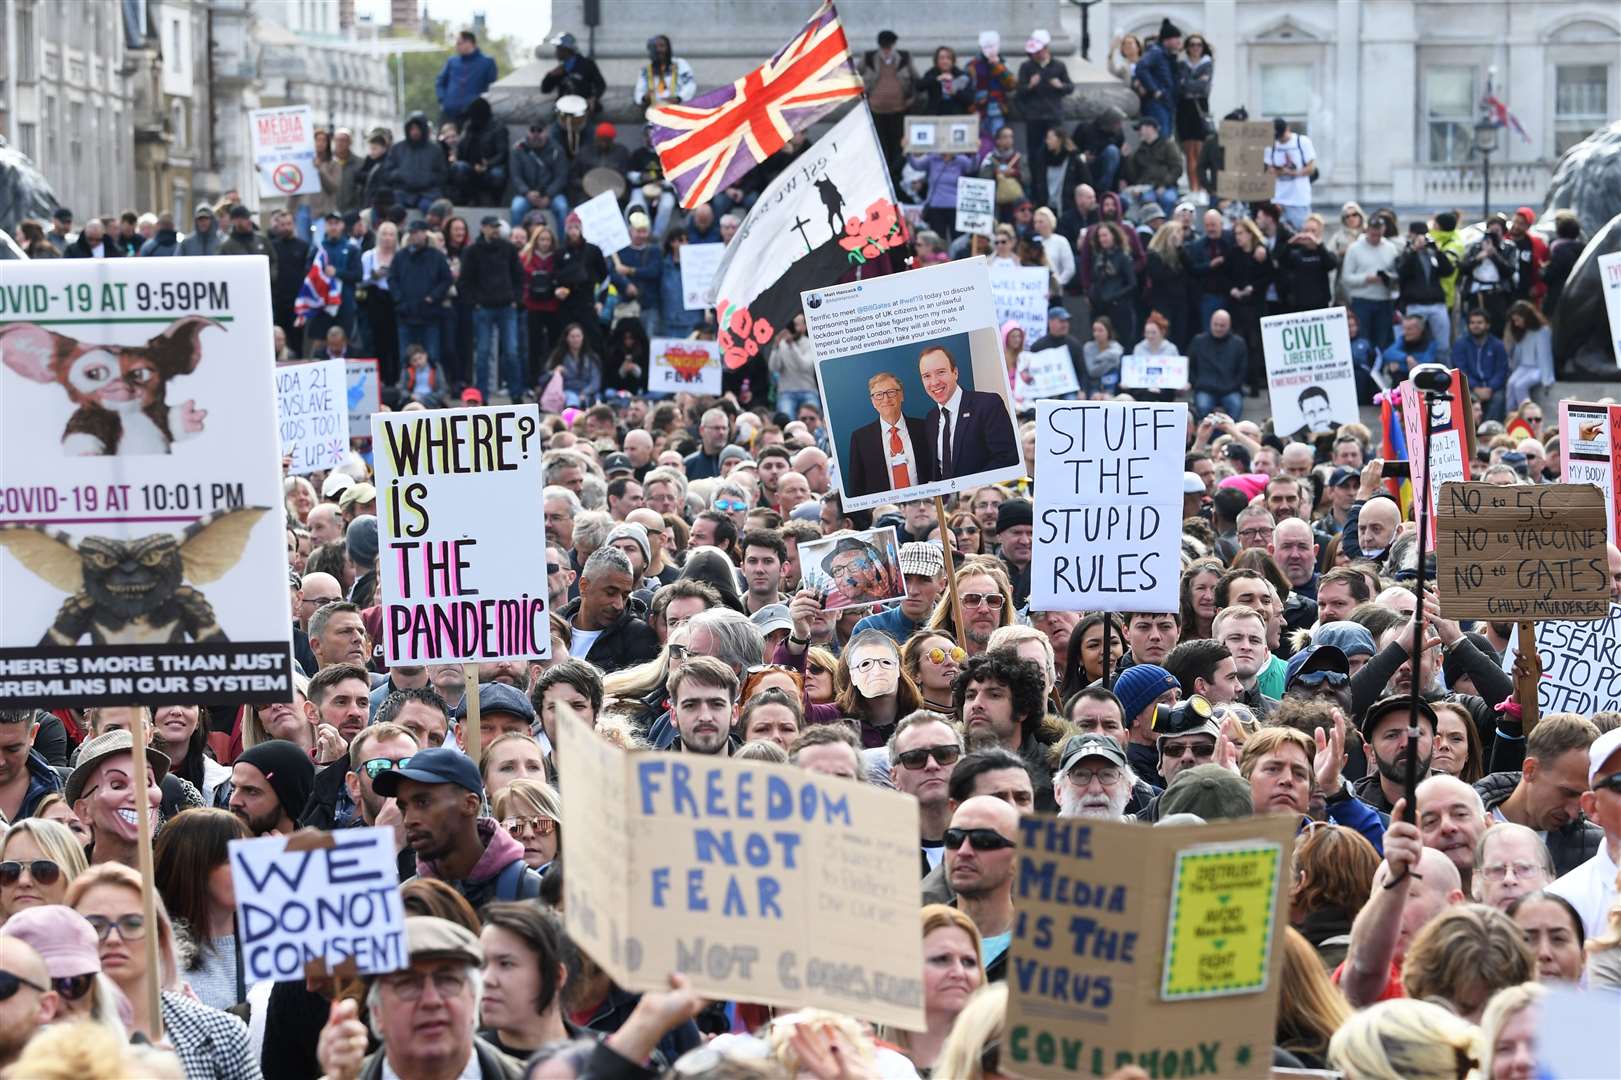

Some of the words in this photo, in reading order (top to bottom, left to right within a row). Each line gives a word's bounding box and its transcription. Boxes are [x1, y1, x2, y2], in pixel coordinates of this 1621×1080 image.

[257, 117, 303, 136] MEDIA
[0, 283, 92, 313] OVID-19
[101, 283, 128, 311] AT
[136, 282, 229, 311] 9:59PM
[811, 313, 830, 321] Terrific
[924, 292, 941, 300] today
[950, 285, 974, 294] discuss
[812, 319, 848, 332] imprisoning
[849, 314, 873, 324] millions
[893, 306, 917, 315] citizens
[935, 296, 961, 306] unlawful
[813, 329, 843, 339] lockdown
[845, 325, 864, 333] based
[875, 319, 890, 327] false
[892, 315, 913, 325] figures
[815, 338, 840, 348] Imperial
[894, 325, 908, 334] They
[863, 337, 894, 348] eventually
[1281, 323, 1331, 350] CIVIL
[1284, 348, 1332, 364] LIBERTIES
[384, 412, 535, 477] WHERE?
[1048, 406, 1175, 456] STUFF
[1064, 457, 1150, 495] THE
[1569, 465, 1583, 478] MY
[1585, 466, 1606, 482] BODY
[106, 485, 131, 511] AT
[142, 483, 202, 511] 10:01
[212, 483, 245, 509] PM
[1450, 486, 1482, 518] NO
[1491, 497, 1505, 508] to
[1517, 490, 1557, 522] 5G
[1039, 505, 1160, 543] STUPID
[1454, 526, 1488, 556] NO
[1514, 527, 1608, 552] VACCINES
[389, 539, 479, 598] THE
[1053, 553, 1160, 594] RULES
[1454, 563, 1483, 595] NO
[1491, 566, 1506, 576] to
[1517, 558, 1606, 592] GATES
[1487, 597, 1528, 614] CHILD
[1534, 600, 1608, 615] MURDERER!
[0, 657, 78, 676] HERE'S
[82, 656, 154, 674] MORE
[159, 655, 226, 672] THAN
[230, 653, 285, 670] JUST
[1559, 653, 1591, 687] TO
[110, 677, 134, 694] IN
[137, 676, 189, 694] OUR
[193, 675, 287, 692] SYSTEM
[1538, 682, 1592, 715] STED
[637, 760, 853, 826] FREEDOM
[694, 829, 802, 869] NOT
[1019, 817, 1094, 860] THE
[236, 839, 383, 893] WE
[651, 868, 783, 919] FEAR
[1018, 856, 1128, 913] MEDIA
[250, 931, 402, 978] CONSENT
[1015, 911, 1055, 951] IS
[1068, 916, 1139, 964] THE
[675, 937, 760, 980] NOT
[1013, 957, 1113, 1009] VIRUS
